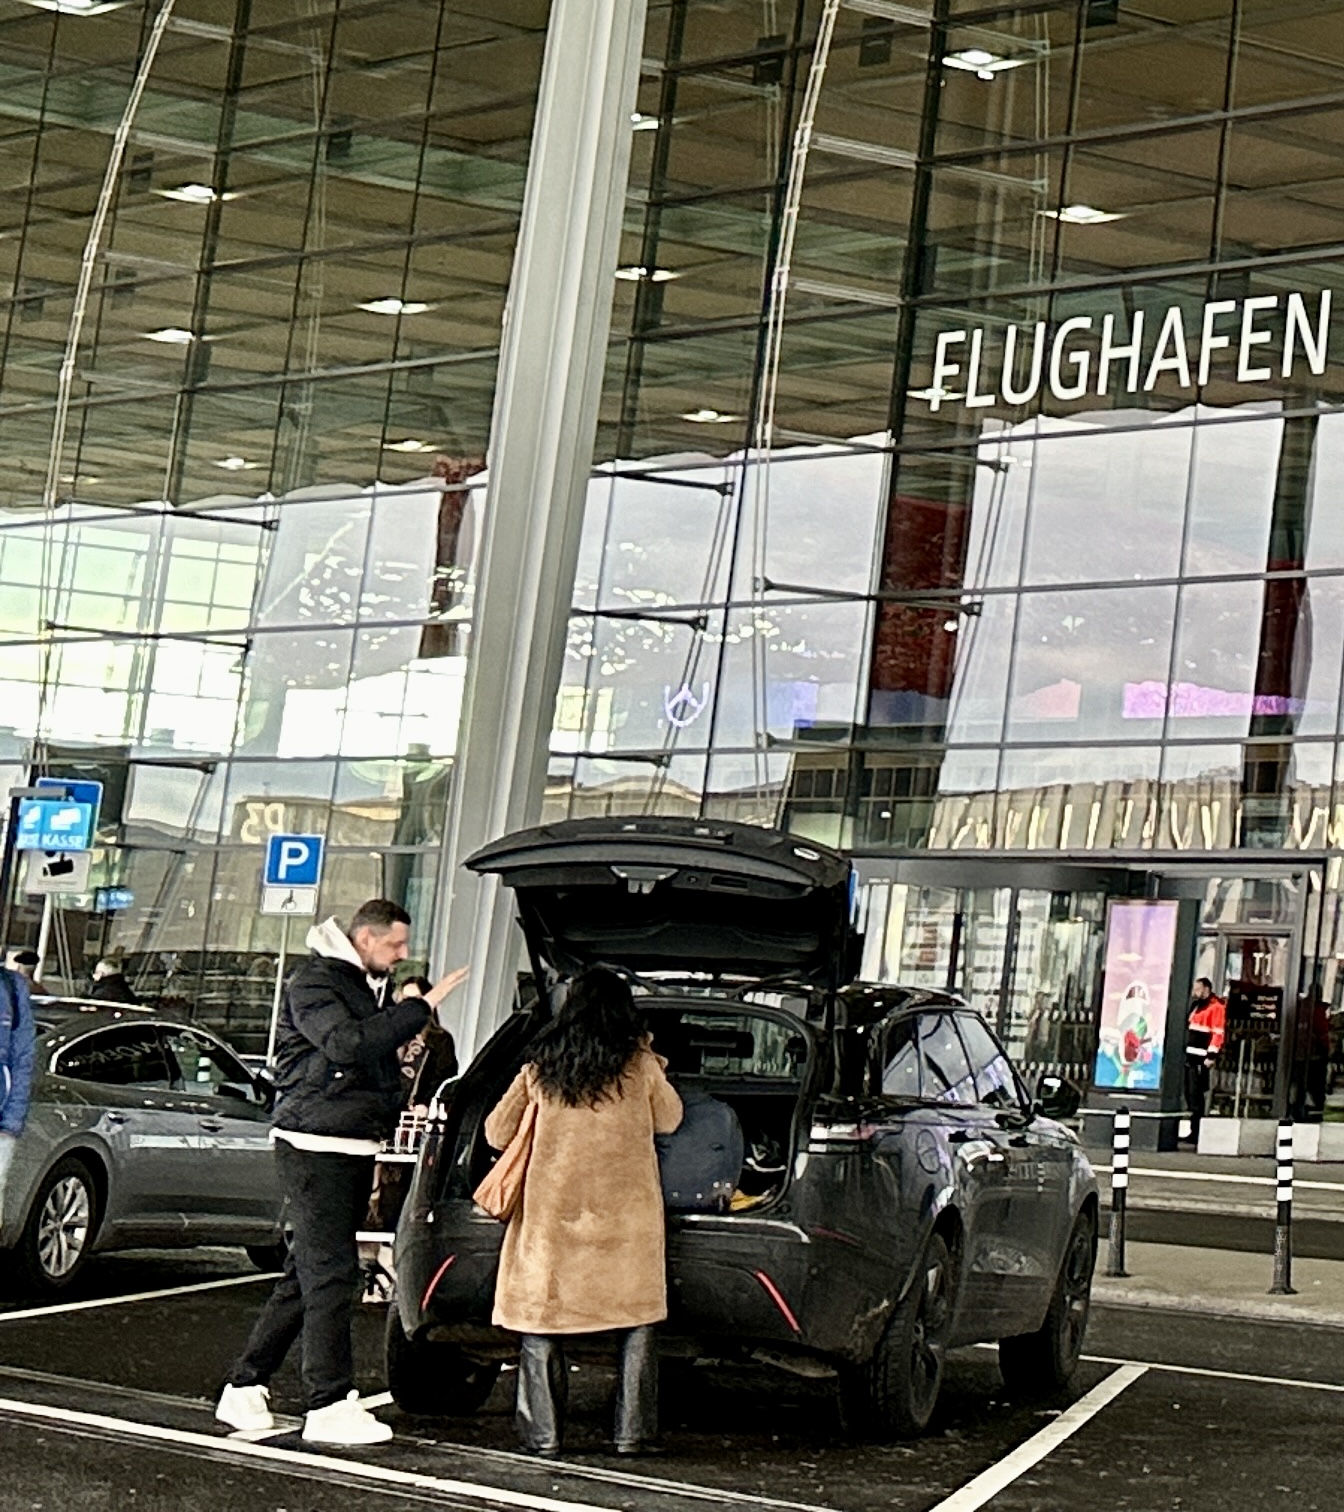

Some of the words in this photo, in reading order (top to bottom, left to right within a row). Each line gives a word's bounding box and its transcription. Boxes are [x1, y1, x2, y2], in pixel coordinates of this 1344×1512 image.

[929, 290, 1332, 412] FLUGHAFEN
[42, 833, 84, 848] KASSE
[278, 840, 309, 880] P
